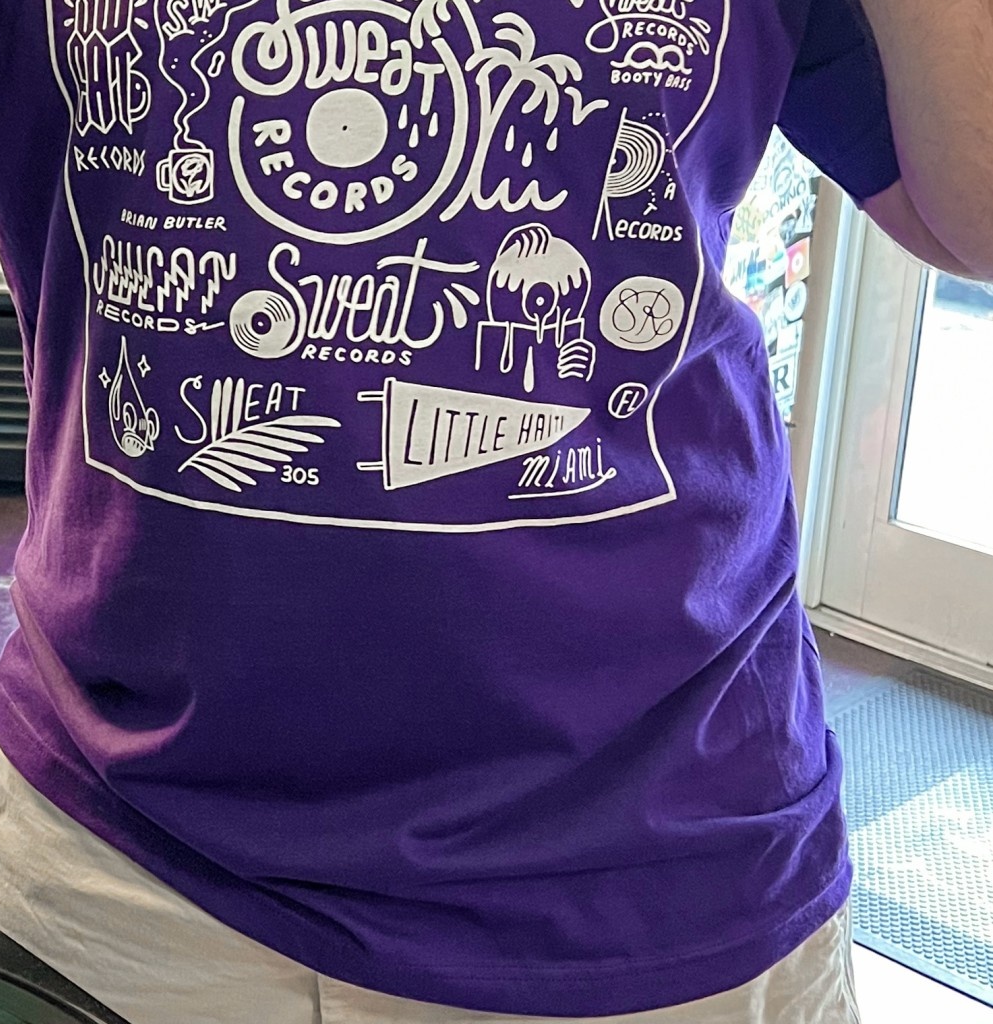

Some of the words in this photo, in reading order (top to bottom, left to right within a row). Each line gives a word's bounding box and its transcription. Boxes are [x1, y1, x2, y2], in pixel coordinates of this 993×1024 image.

[622, 21, 696, 56] RECORDS
[610, 70, 662, 88] BOOTY
[664, 72, 692, 92] BASS
[73, 145, 146, 177] RECORDS
[253, 118, 419, 215] RECORDS
[163, 215, 227, 232] BUTLER
[267, 237, 480, 358] Sweat
[96, 298, 225, 335] RECORDS
[300, 344, 413, 366] RECORDS
[174, 375, 306, 445] SWEAT
[617, 390, 641, 418] FL
[403, 398, 507, 466] LITTLE
[517, 413, 564, 445] HAITI
[280, 465, 320, 486] 305
